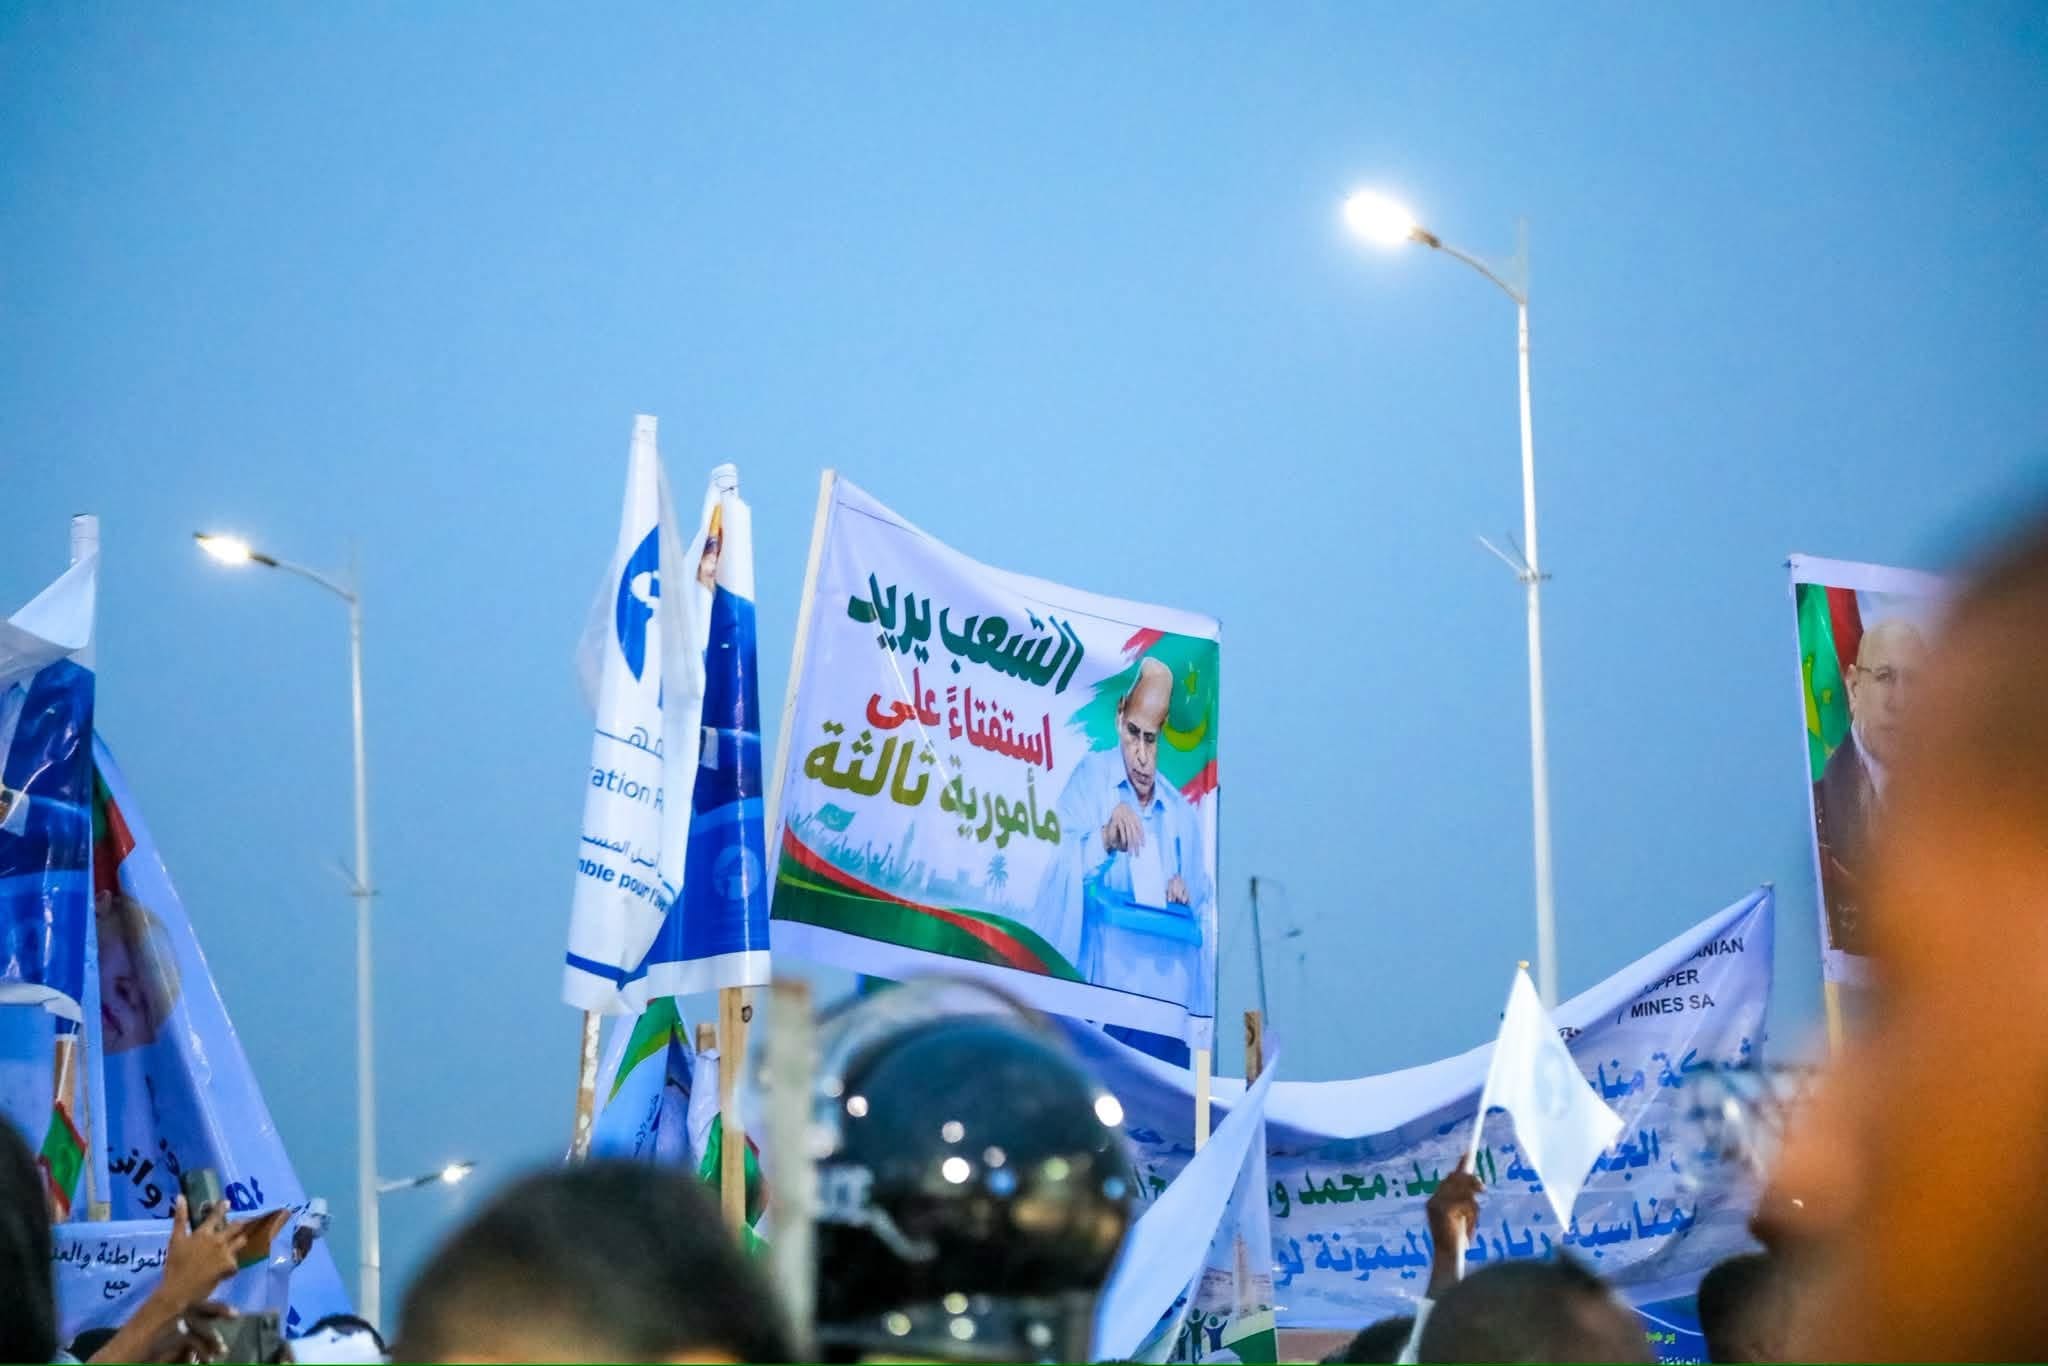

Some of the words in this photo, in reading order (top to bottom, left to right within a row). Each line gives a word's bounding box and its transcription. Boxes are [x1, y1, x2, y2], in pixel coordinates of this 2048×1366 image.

[847, 572, 932, 665] يريد
[939, 607, 1084, 695] الشعب
[866, 667, 941, 730] على
[590, 767, 651, 804] ation
[804, 720, 936, 807] ثالثة
[940, 754, 1061, 849] مأمورية
[1687, 937, 1745, 961] ANIAN
[1630, 997, 1685, 1019] MINES
[1688, 993, 1715, 1010] SA
[1298, 1168, 1388, 1206] محمد
